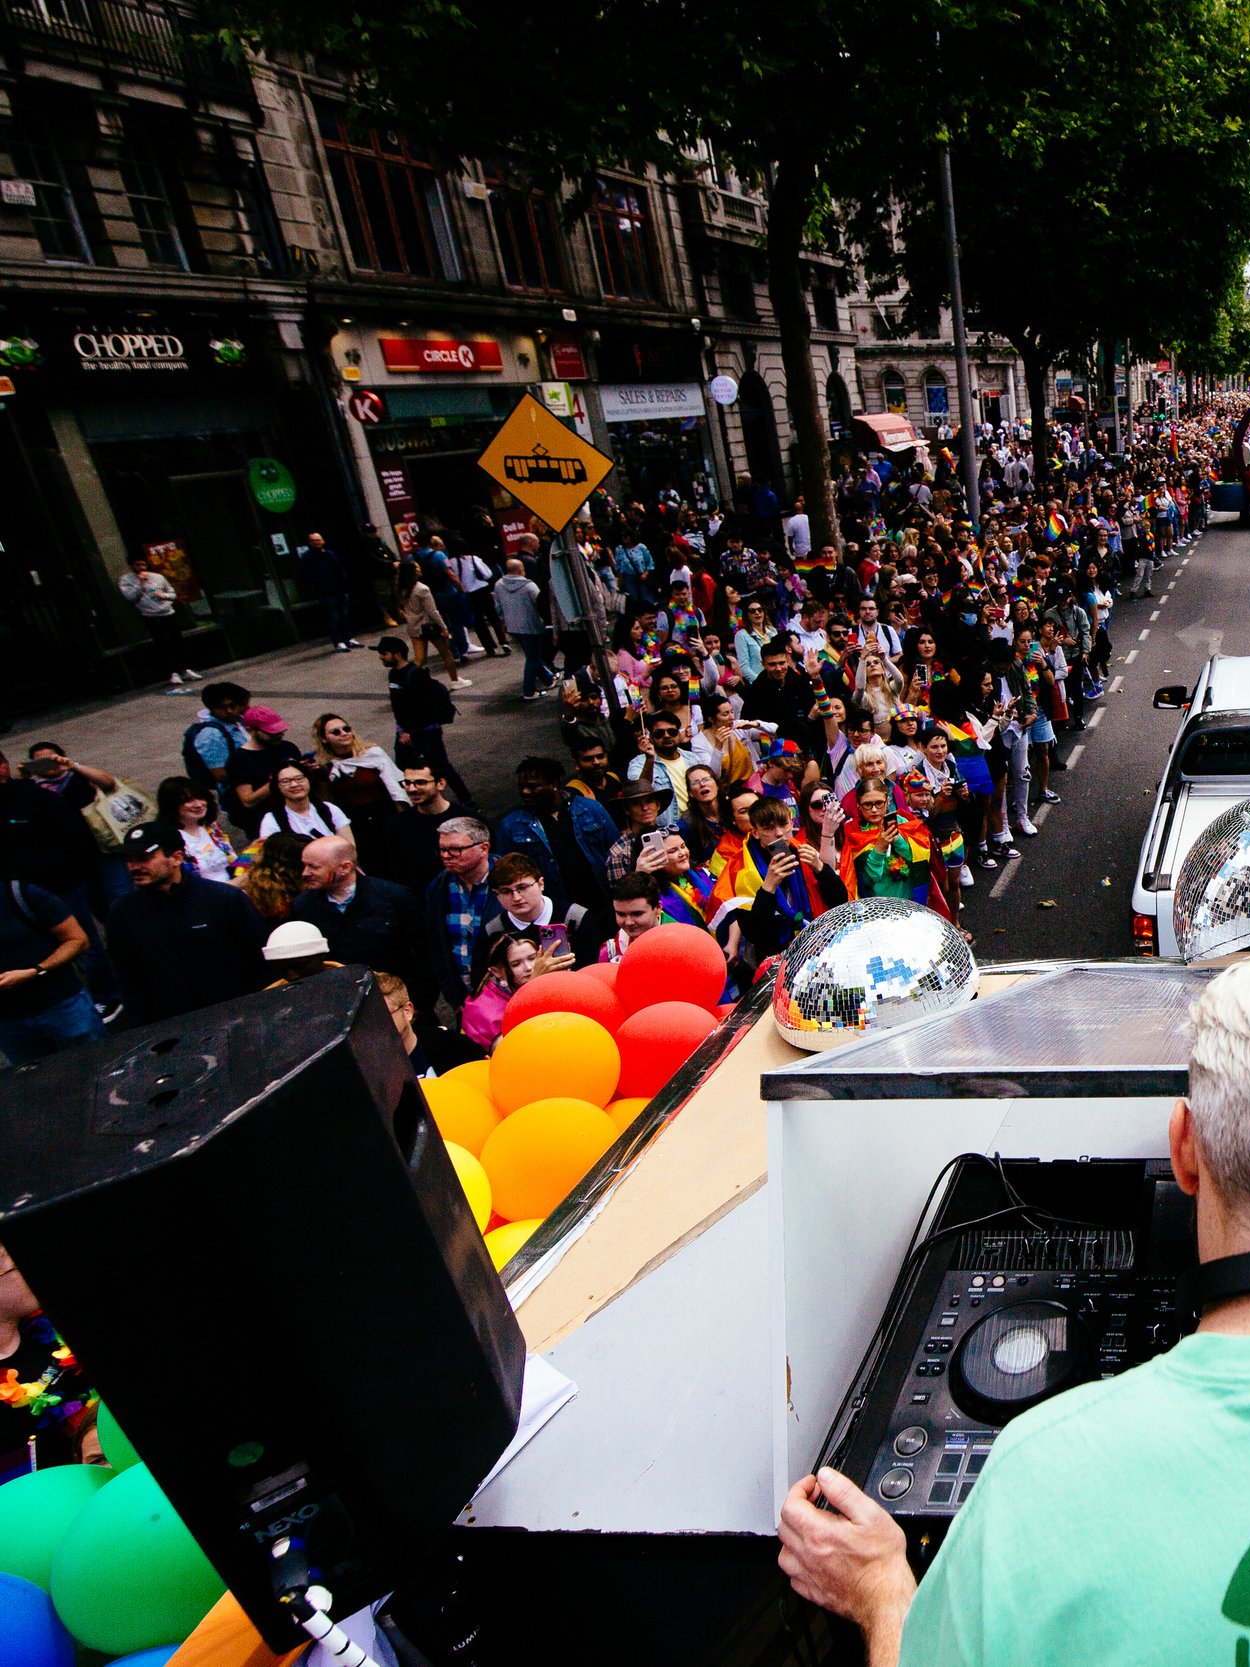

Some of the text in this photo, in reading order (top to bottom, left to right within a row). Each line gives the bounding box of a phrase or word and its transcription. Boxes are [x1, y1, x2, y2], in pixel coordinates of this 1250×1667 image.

[73, 333, 184, 358] CHOPPED
[423, 344, 475, 368] CIRCLE K
[619, 388, 647, 405] SALES
[654, 386, 688, 403] REPAIRS
[354, 399, 380, 423] K
[254, 1503, 319, 1543] NEXO
